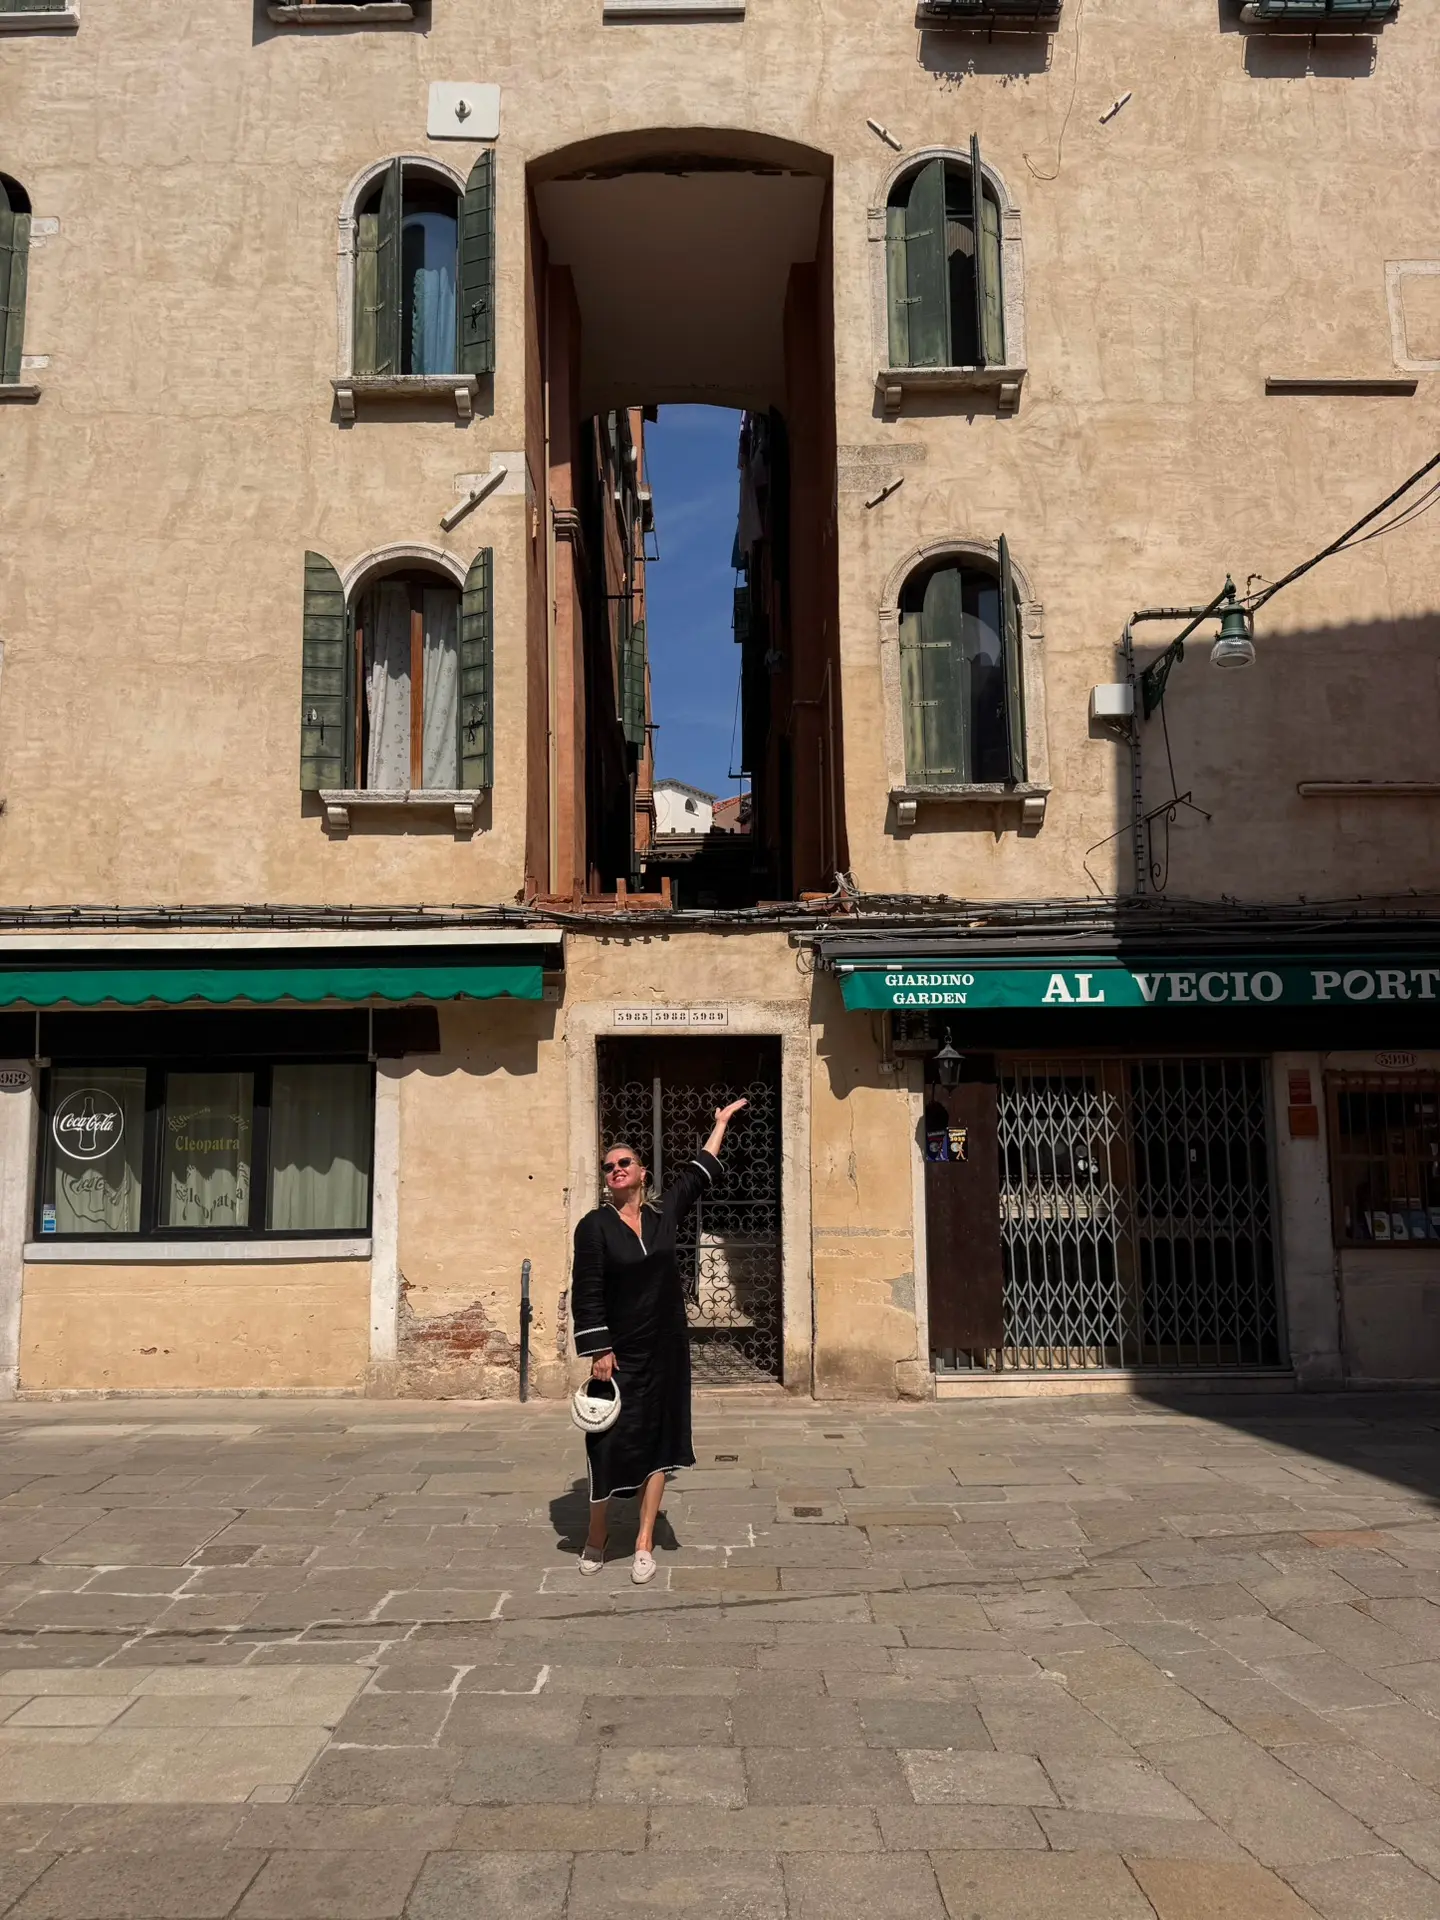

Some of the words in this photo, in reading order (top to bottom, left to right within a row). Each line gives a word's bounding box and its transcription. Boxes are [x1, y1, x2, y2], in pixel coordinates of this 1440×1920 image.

[885, 973, 975, 986] GIARDINO
[1041, 973, 1105, 1003] AL
[1131, 971, 1284, 1002] VECIO
[1310, 969, 1440, 1001] PORT
[892, 992, 967, 1005] GARDEN
[617, 1012, 649, 1021] 5985
[655, 1012, 686, 1021] 5988
[692, 1012, 724, 1021] 5989
[0, 1072, 27, 1085] 982
[59, 1112, 117, 1131] Coca-Cola
[175, 1135, 240, 1154] Cleopatra
